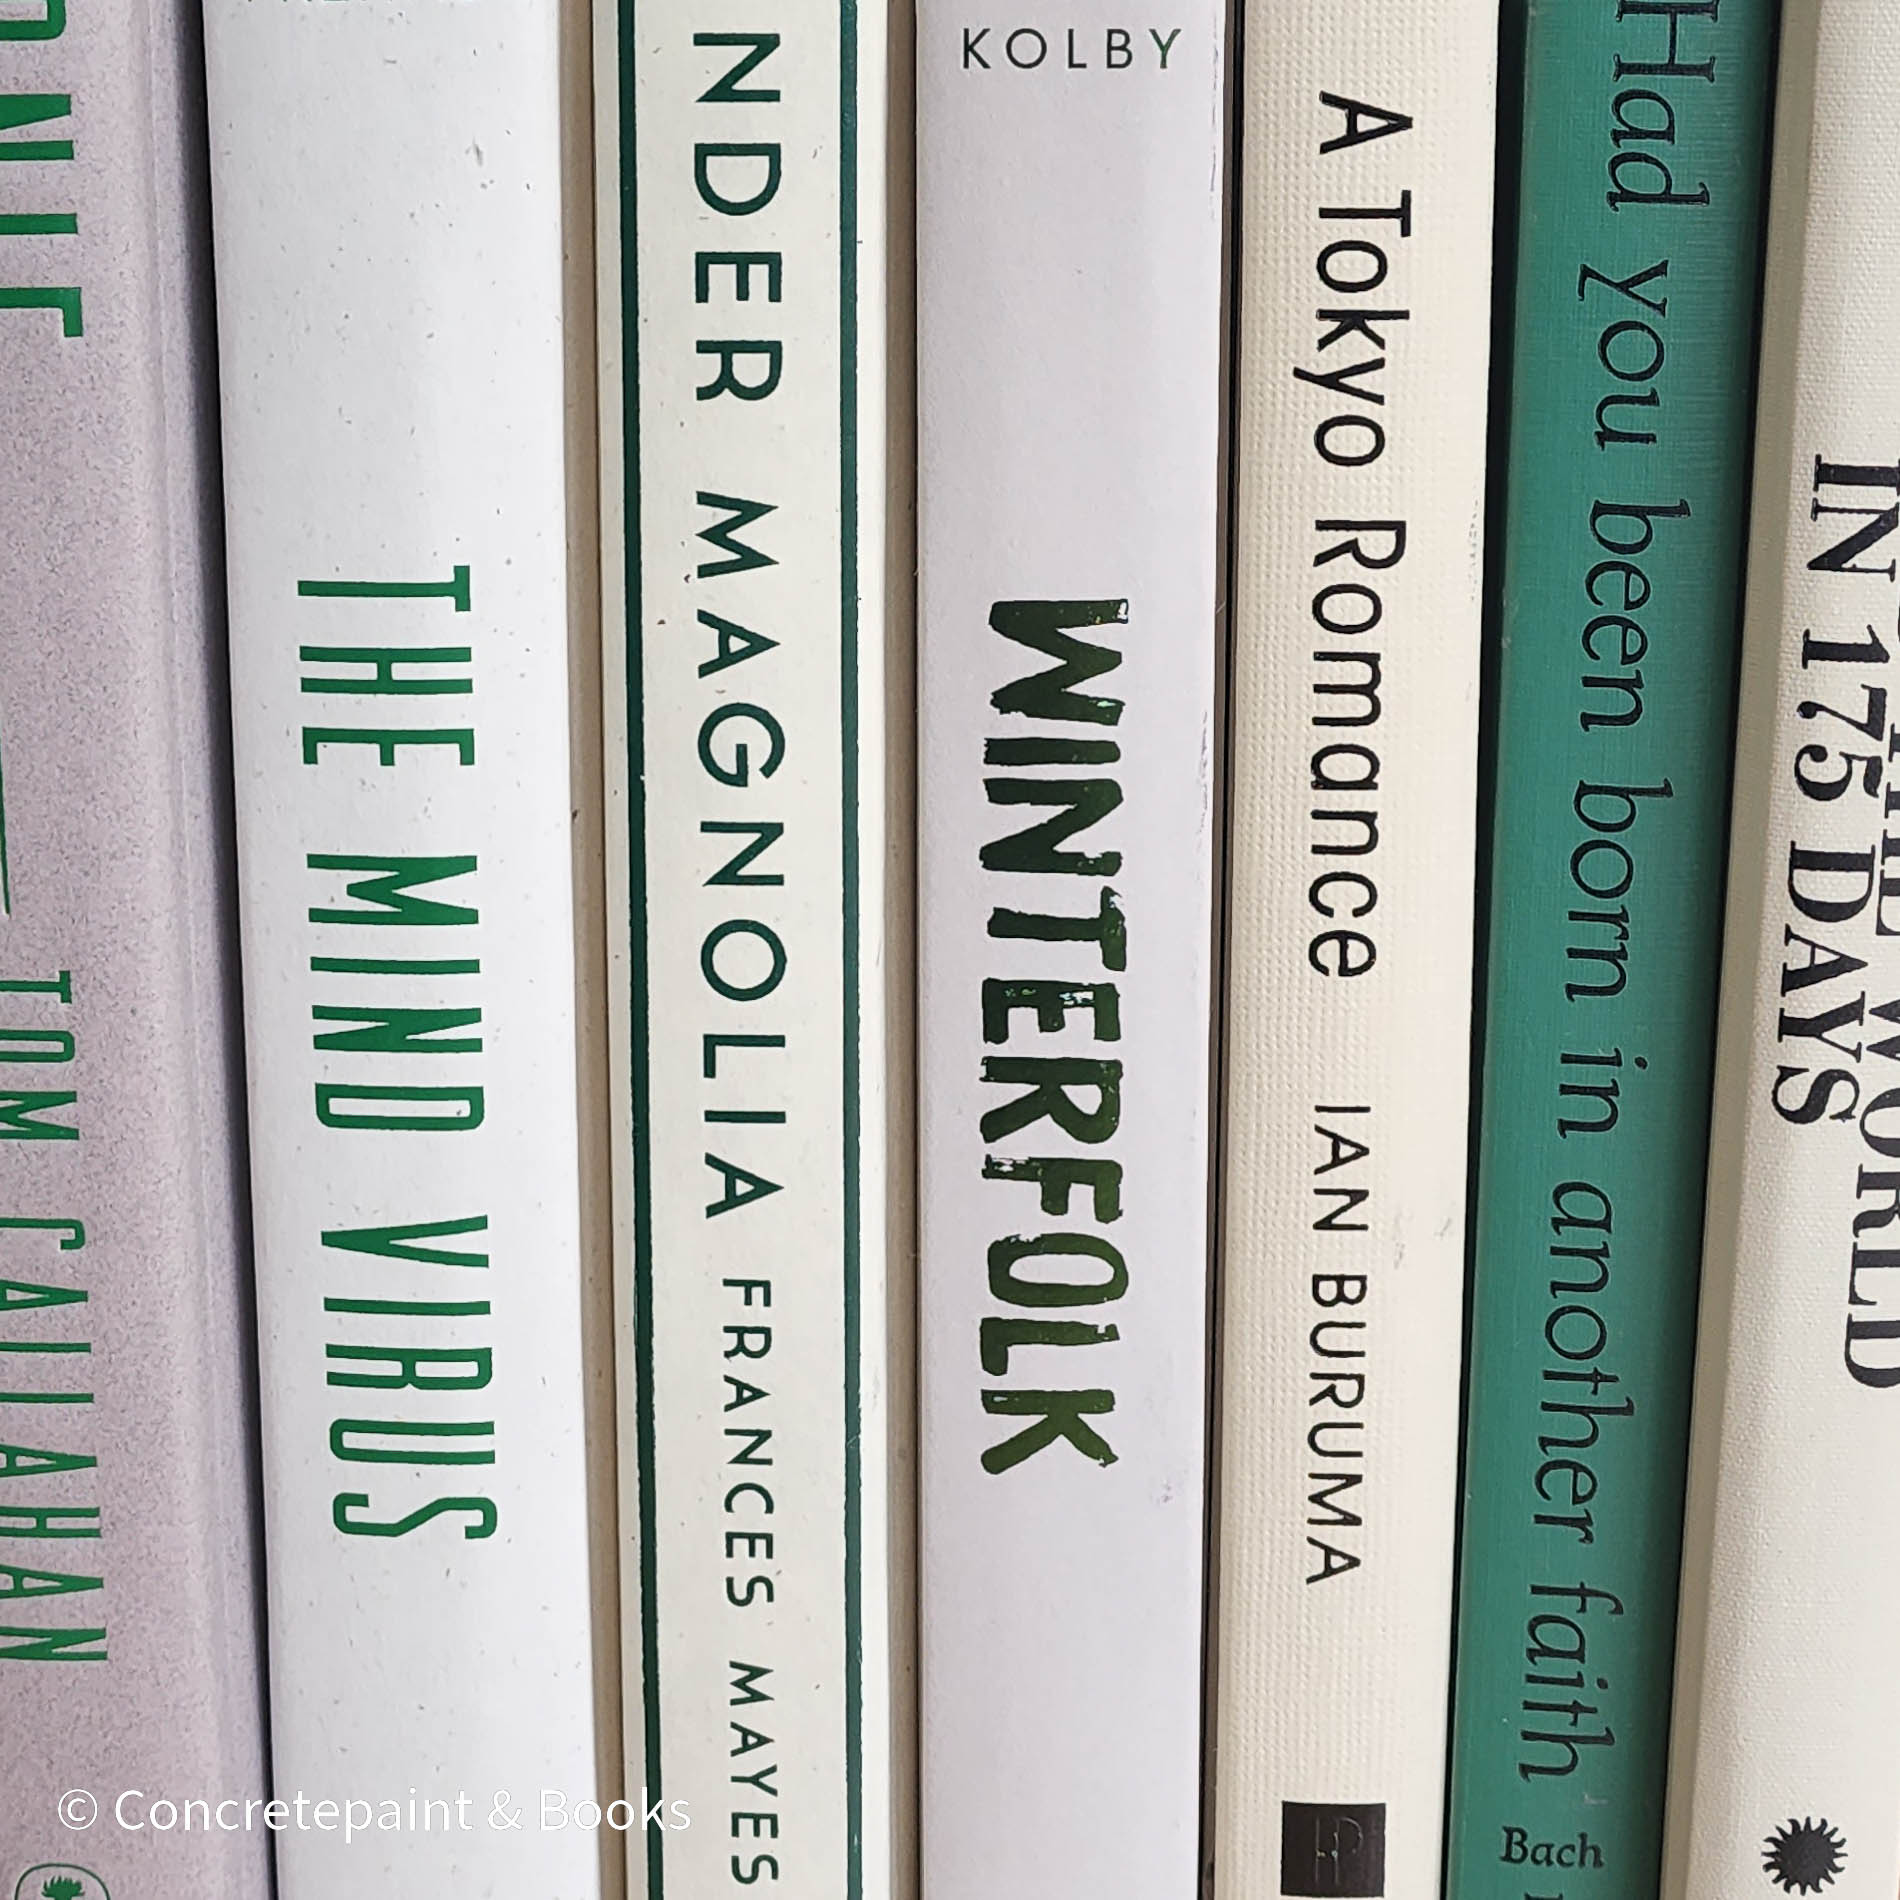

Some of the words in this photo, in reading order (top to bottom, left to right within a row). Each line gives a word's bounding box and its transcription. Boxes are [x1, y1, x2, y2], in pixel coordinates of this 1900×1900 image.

[963, 28, 1181, 69] KOLBY
[1319, 91, 1413, 155] A
[1607, 0, 1718, 211] Had
[693, 33, 783, 401] NDER
[1293, 189, 1412, 468] Tokyo
[1578, 260, 1668, 450] you
[1579, 499, 1691, 731] been
[1806, 454, 1900, 582] IN
[297, 565, 475, 767] THE
[1308, 519, 1407, 978] Romance
[1794, 624, 1890, 802] 175
[696, 490, 788, 1219] MAGNOLIA
[1566, 778, 1675, 1003] born
[307, 853, 485, 1132] MIND
[978, 598, 1130, 1476] WINTERFOLK
[1556, 1047, 1648, 1140] in
[1771, 840, 1876, 1125] DAYS
[1312, 1104, 1371, 1232] IAN
[320, 1214, 498, 1540] VIRUS
[723, 1278, 775, 1607] FRANCES
[1305, 1273, 1368, 1585] BURUMA
[1534, 1180, 1636, 1545] another
[729, 1660, 779, 1885] MAYES
[1518, 1582, 1625, 1783] faith
[1500, 1826, 1605, 1869] Bach
